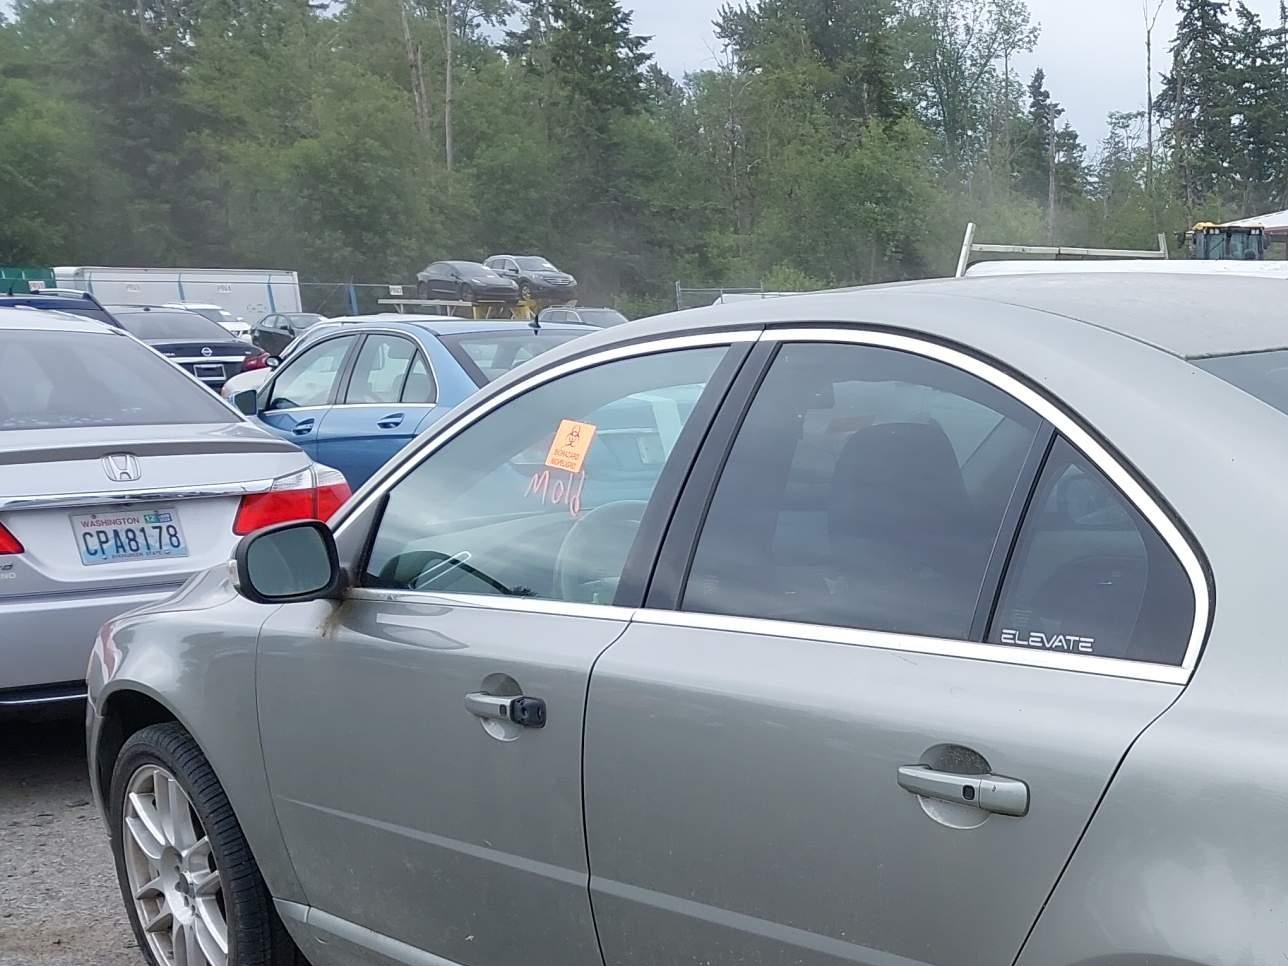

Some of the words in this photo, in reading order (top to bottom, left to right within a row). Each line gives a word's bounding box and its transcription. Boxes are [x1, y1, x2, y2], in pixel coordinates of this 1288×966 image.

[80, 517, 140, 528] WASHINGTON
[82, 525, 181, 556] CPA8178
[1000, 629, 1095, 652] ELEVATE
